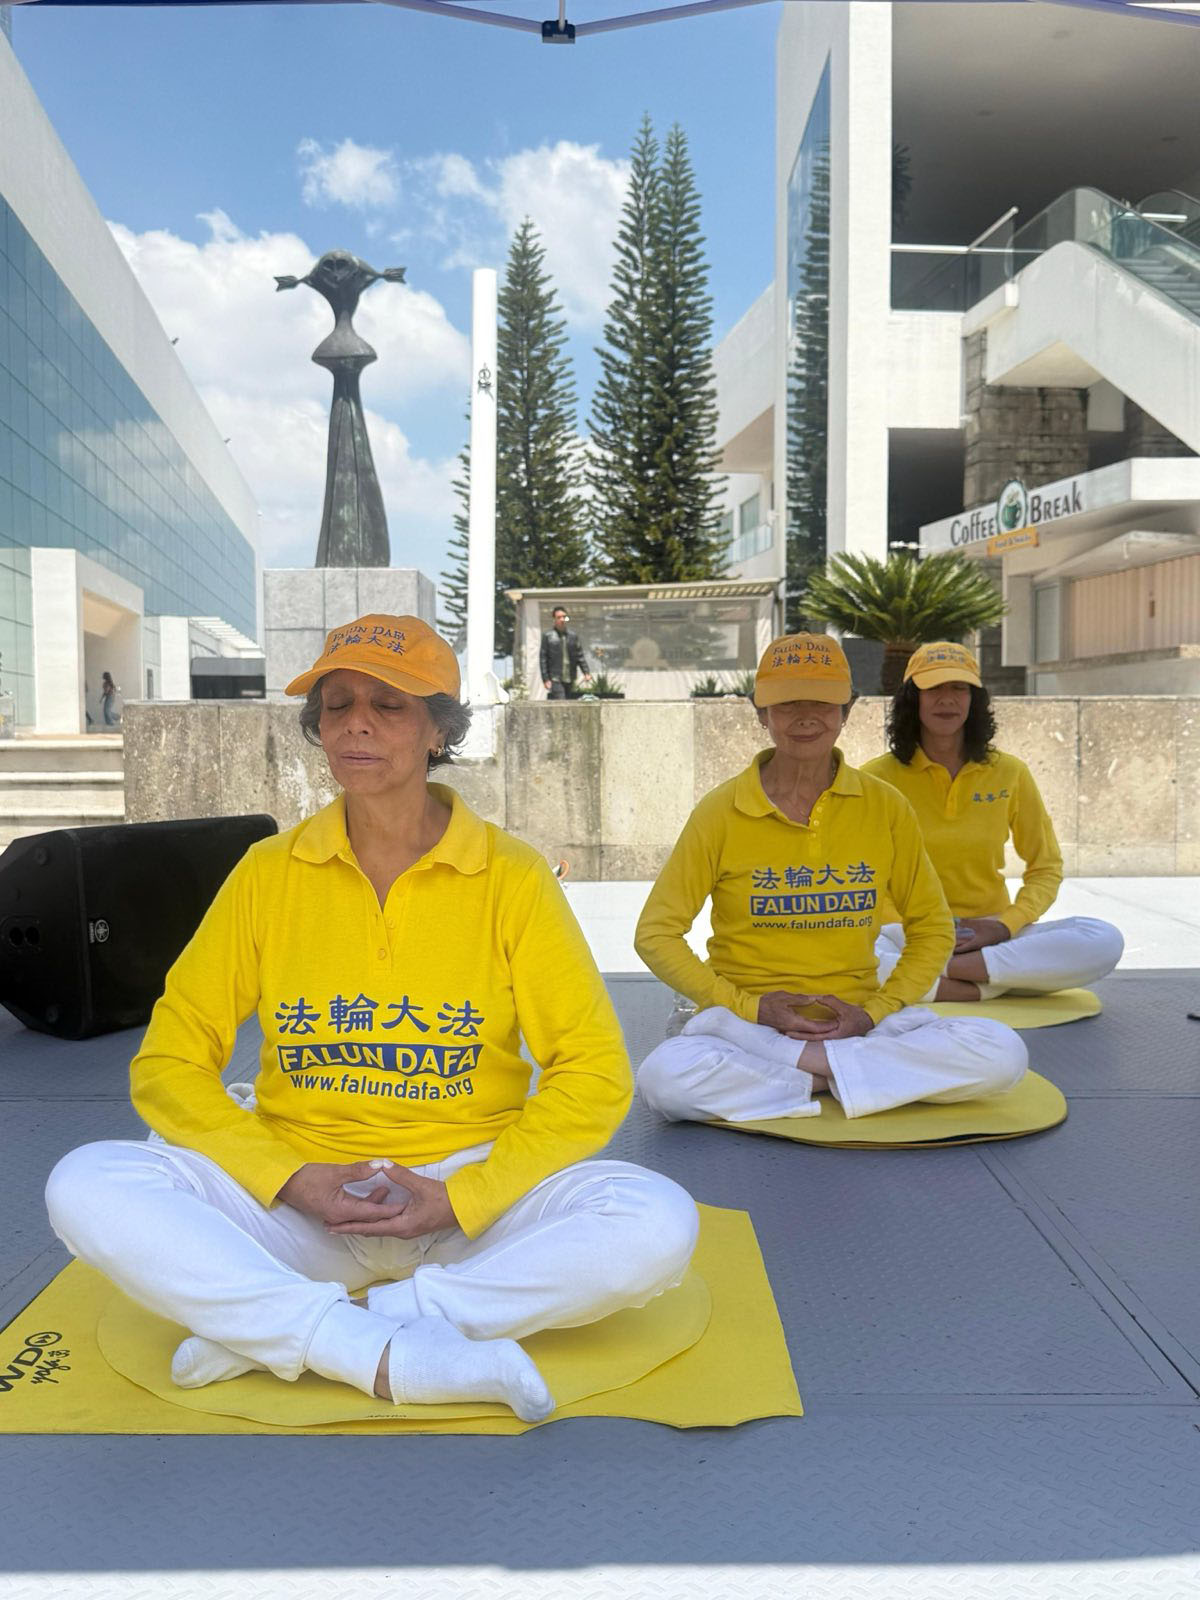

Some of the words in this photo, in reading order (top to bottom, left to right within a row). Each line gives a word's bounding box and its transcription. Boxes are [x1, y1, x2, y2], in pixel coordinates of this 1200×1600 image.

[752, 862, 876, 890] 法輪大法
[752, 896, 820, 914] FALUN
[825, 892, 875, 911] DAFA
[752, 916, 873, 929] www.falundafa.org
[275, 993, 485, 1037] 法輪大法
[279, 1042, 385, 1071] FALUN
[395, 1048, 475, 1075] DAFA
[289, 1073, 474, 1100] www.falundafa.org
